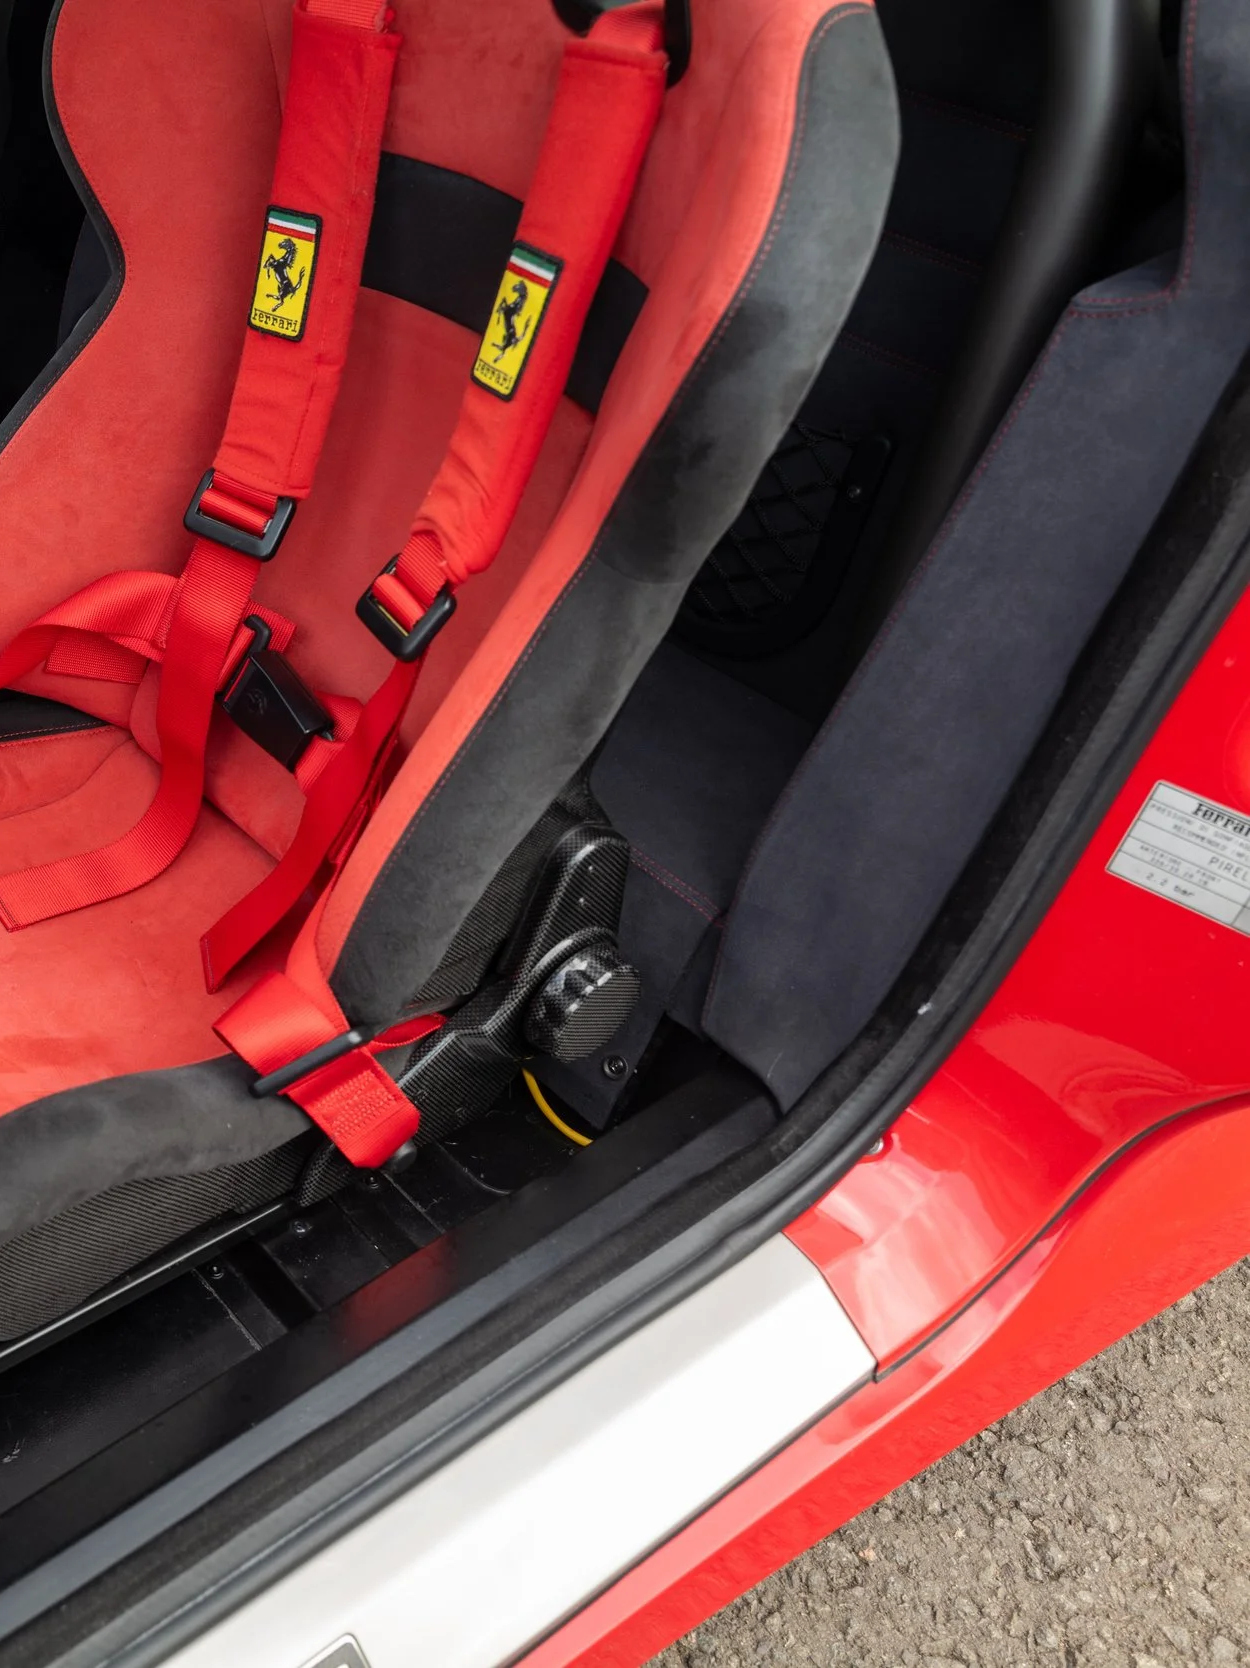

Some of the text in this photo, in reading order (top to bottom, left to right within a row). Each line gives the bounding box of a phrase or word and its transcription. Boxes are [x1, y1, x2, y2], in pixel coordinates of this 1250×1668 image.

[252, 307, 299, 333] Ferrari
[476, 358, 514, 390] Ferrari
[1145, 872, 1195, 897] 2.2 bar
